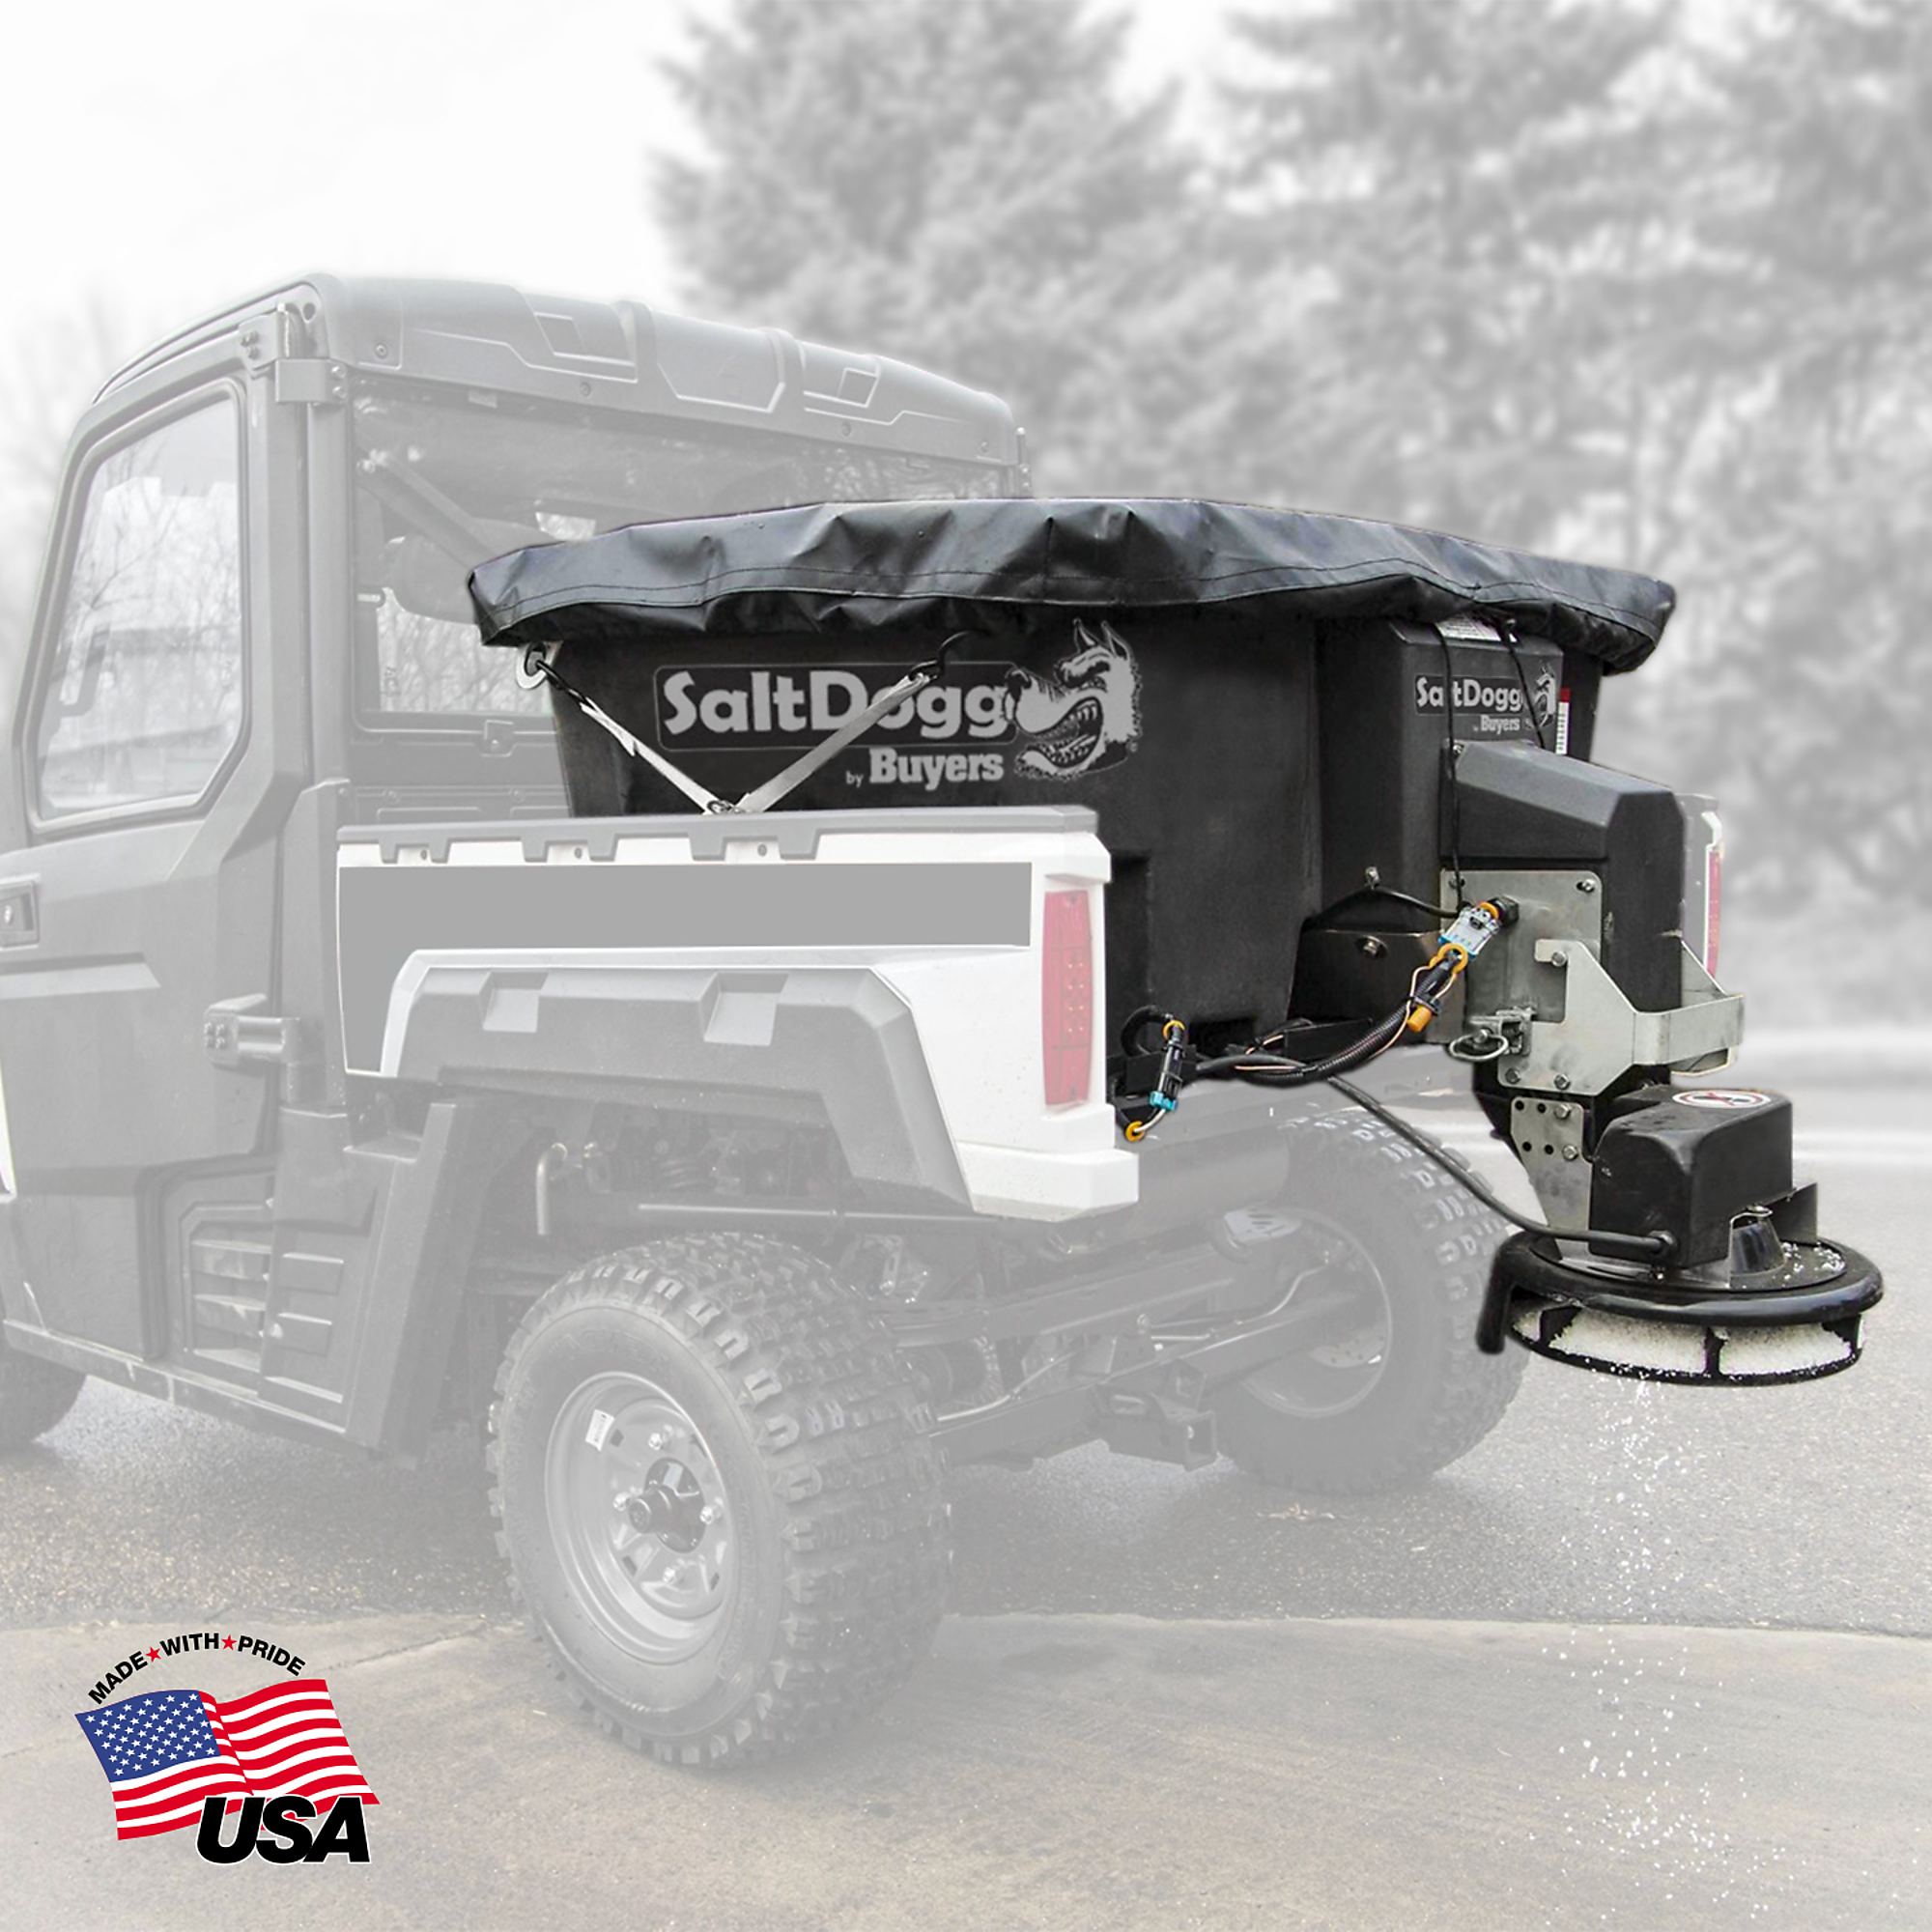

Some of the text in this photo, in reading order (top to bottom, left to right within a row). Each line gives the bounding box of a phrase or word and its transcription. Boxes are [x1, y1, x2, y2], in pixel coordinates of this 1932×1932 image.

[1416, 676, 1522, 712] SatDogg
[1480, 715, 1520, 735] Buyers
[846, 748, 1004, 790] by Buyers
